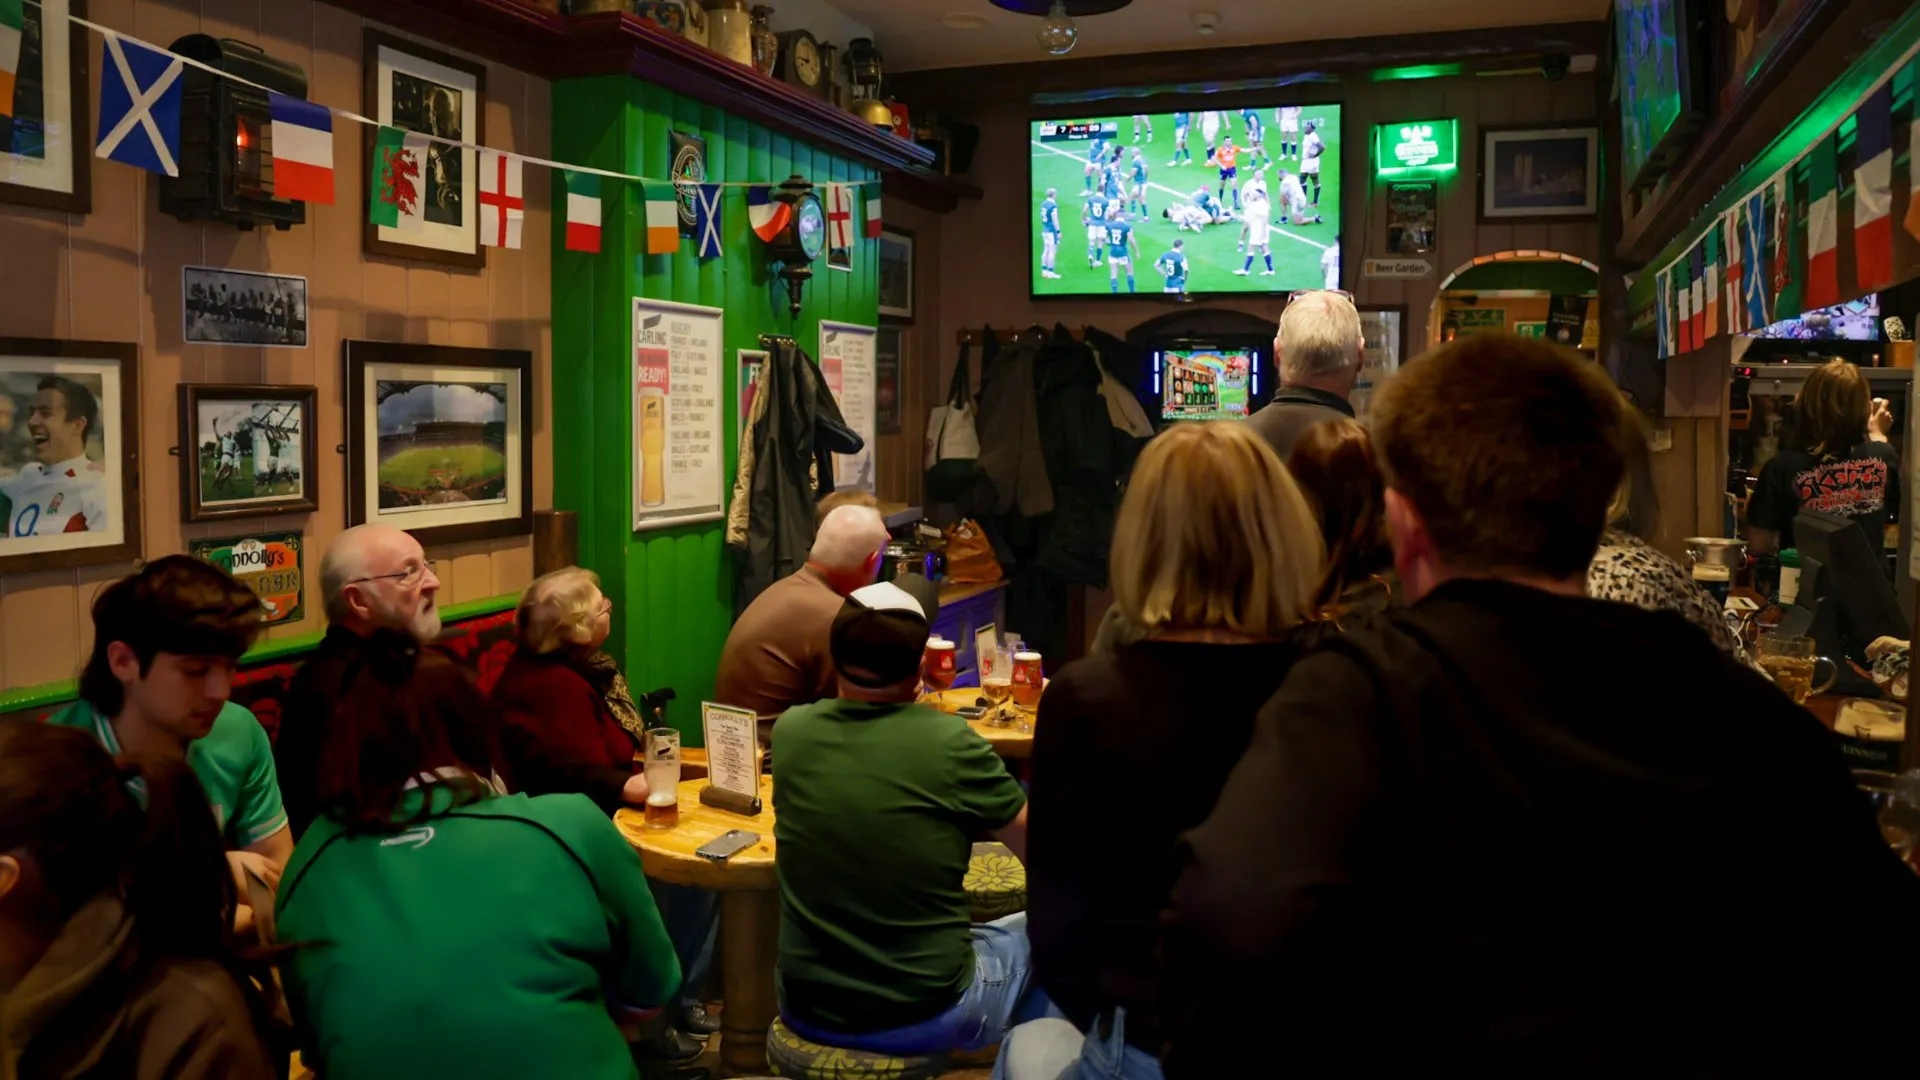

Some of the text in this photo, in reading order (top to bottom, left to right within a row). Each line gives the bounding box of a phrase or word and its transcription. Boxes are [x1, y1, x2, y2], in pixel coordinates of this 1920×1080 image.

[1376, 263, 1425, 273] Beer Garden
[638, 329, 667, 345] CARLING
[638, 366, 668, 384] READY!
[220, 549, 285, 570] onnolly's
